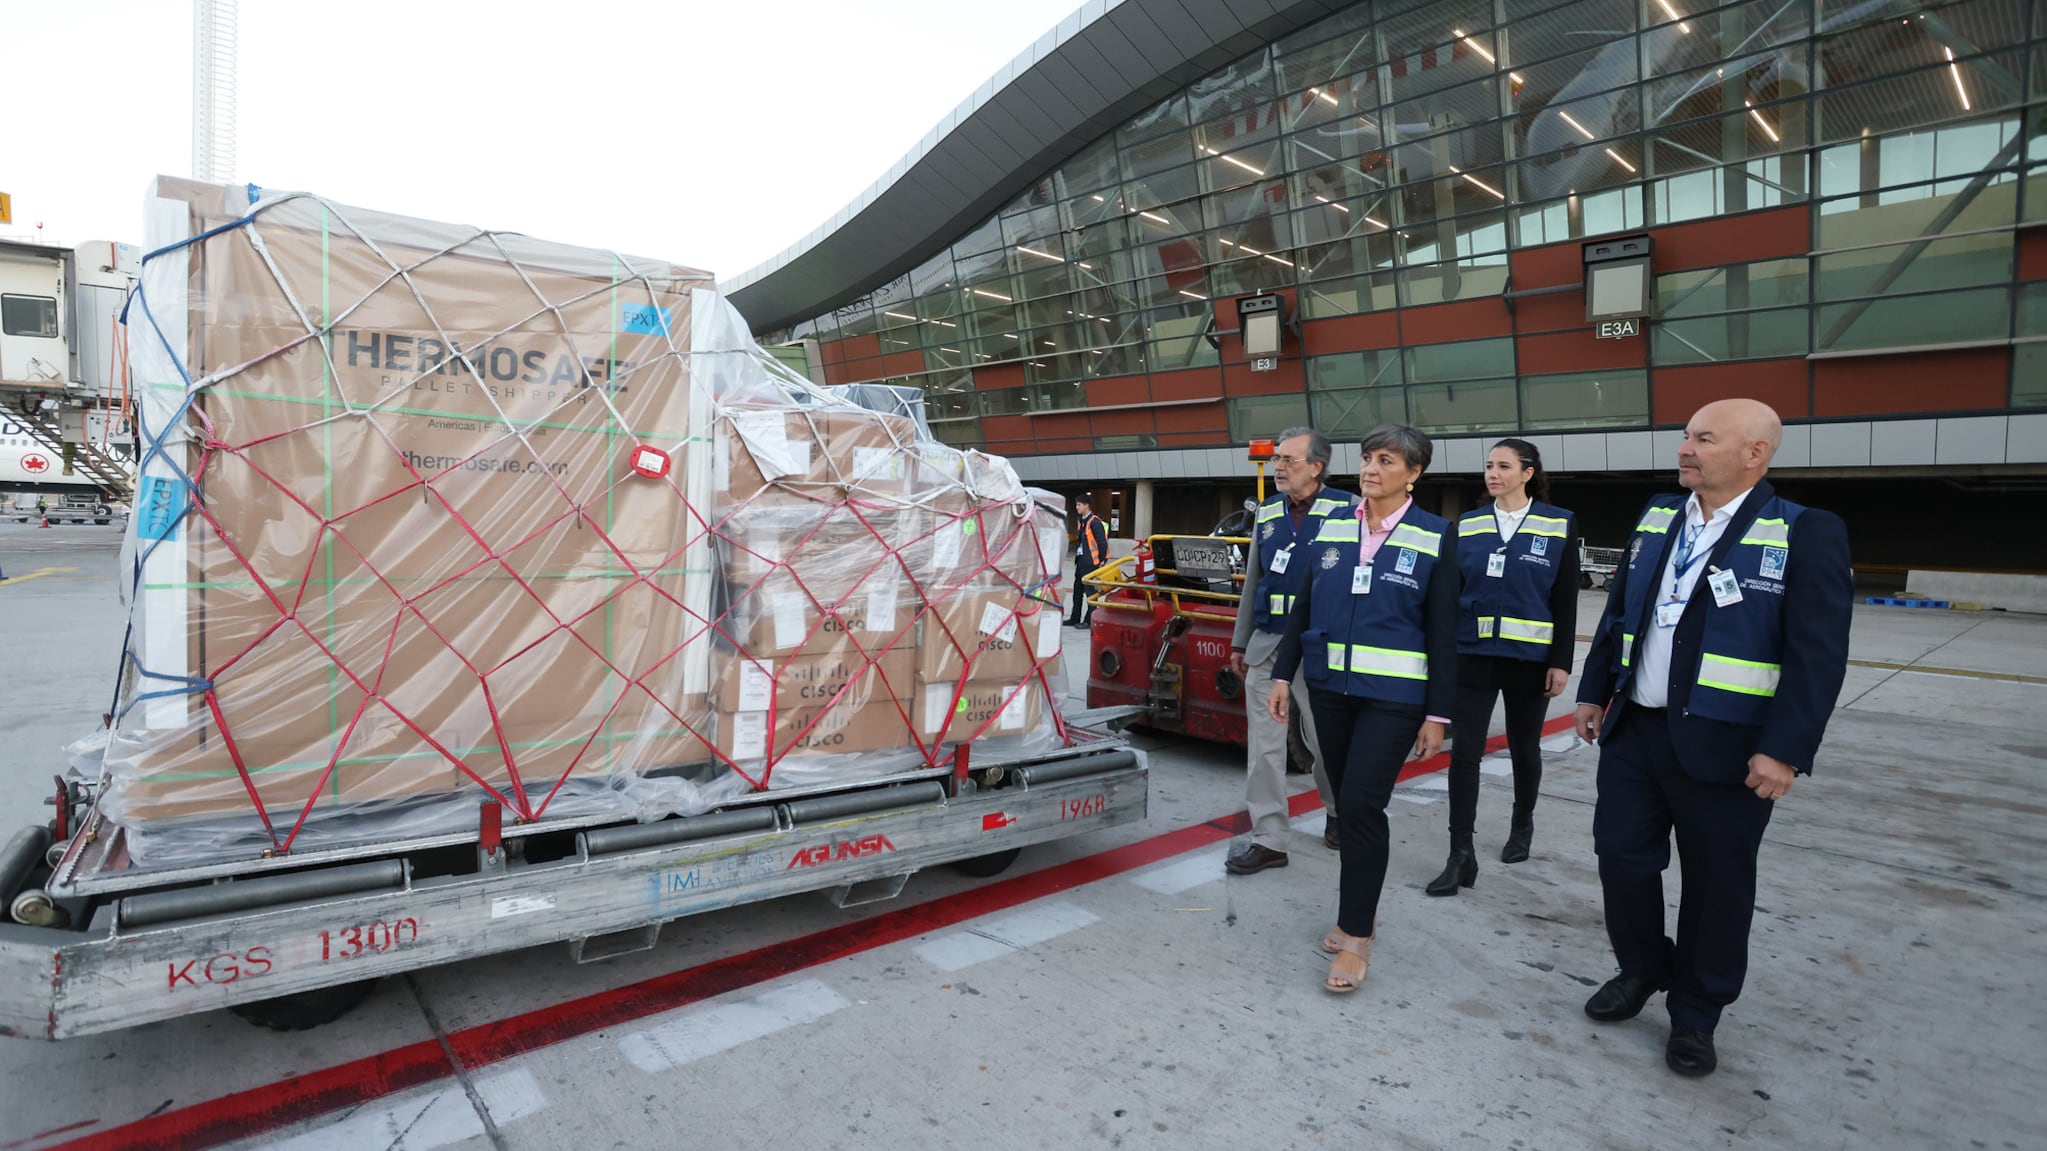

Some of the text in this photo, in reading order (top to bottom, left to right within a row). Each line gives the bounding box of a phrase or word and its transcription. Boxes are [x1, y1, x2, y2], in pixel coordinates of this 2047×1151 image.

[1601, 321, 1634, 336] E3A
[318, 327, 629, 392] THERMOSAFE
[1257, 358, 1270, 369] E3
[381, 375, 471, 394] PALLET
[428, 419, 476, 431] Americas
[824, 619, 865, 632] CISCO
[978, 640, 1013, 651] CISCO
[1197, 640, 1226, 658] 1100
[786, 834, 897, 871] AGUNSA
[168, 917, 418, 993] KGS 1300
